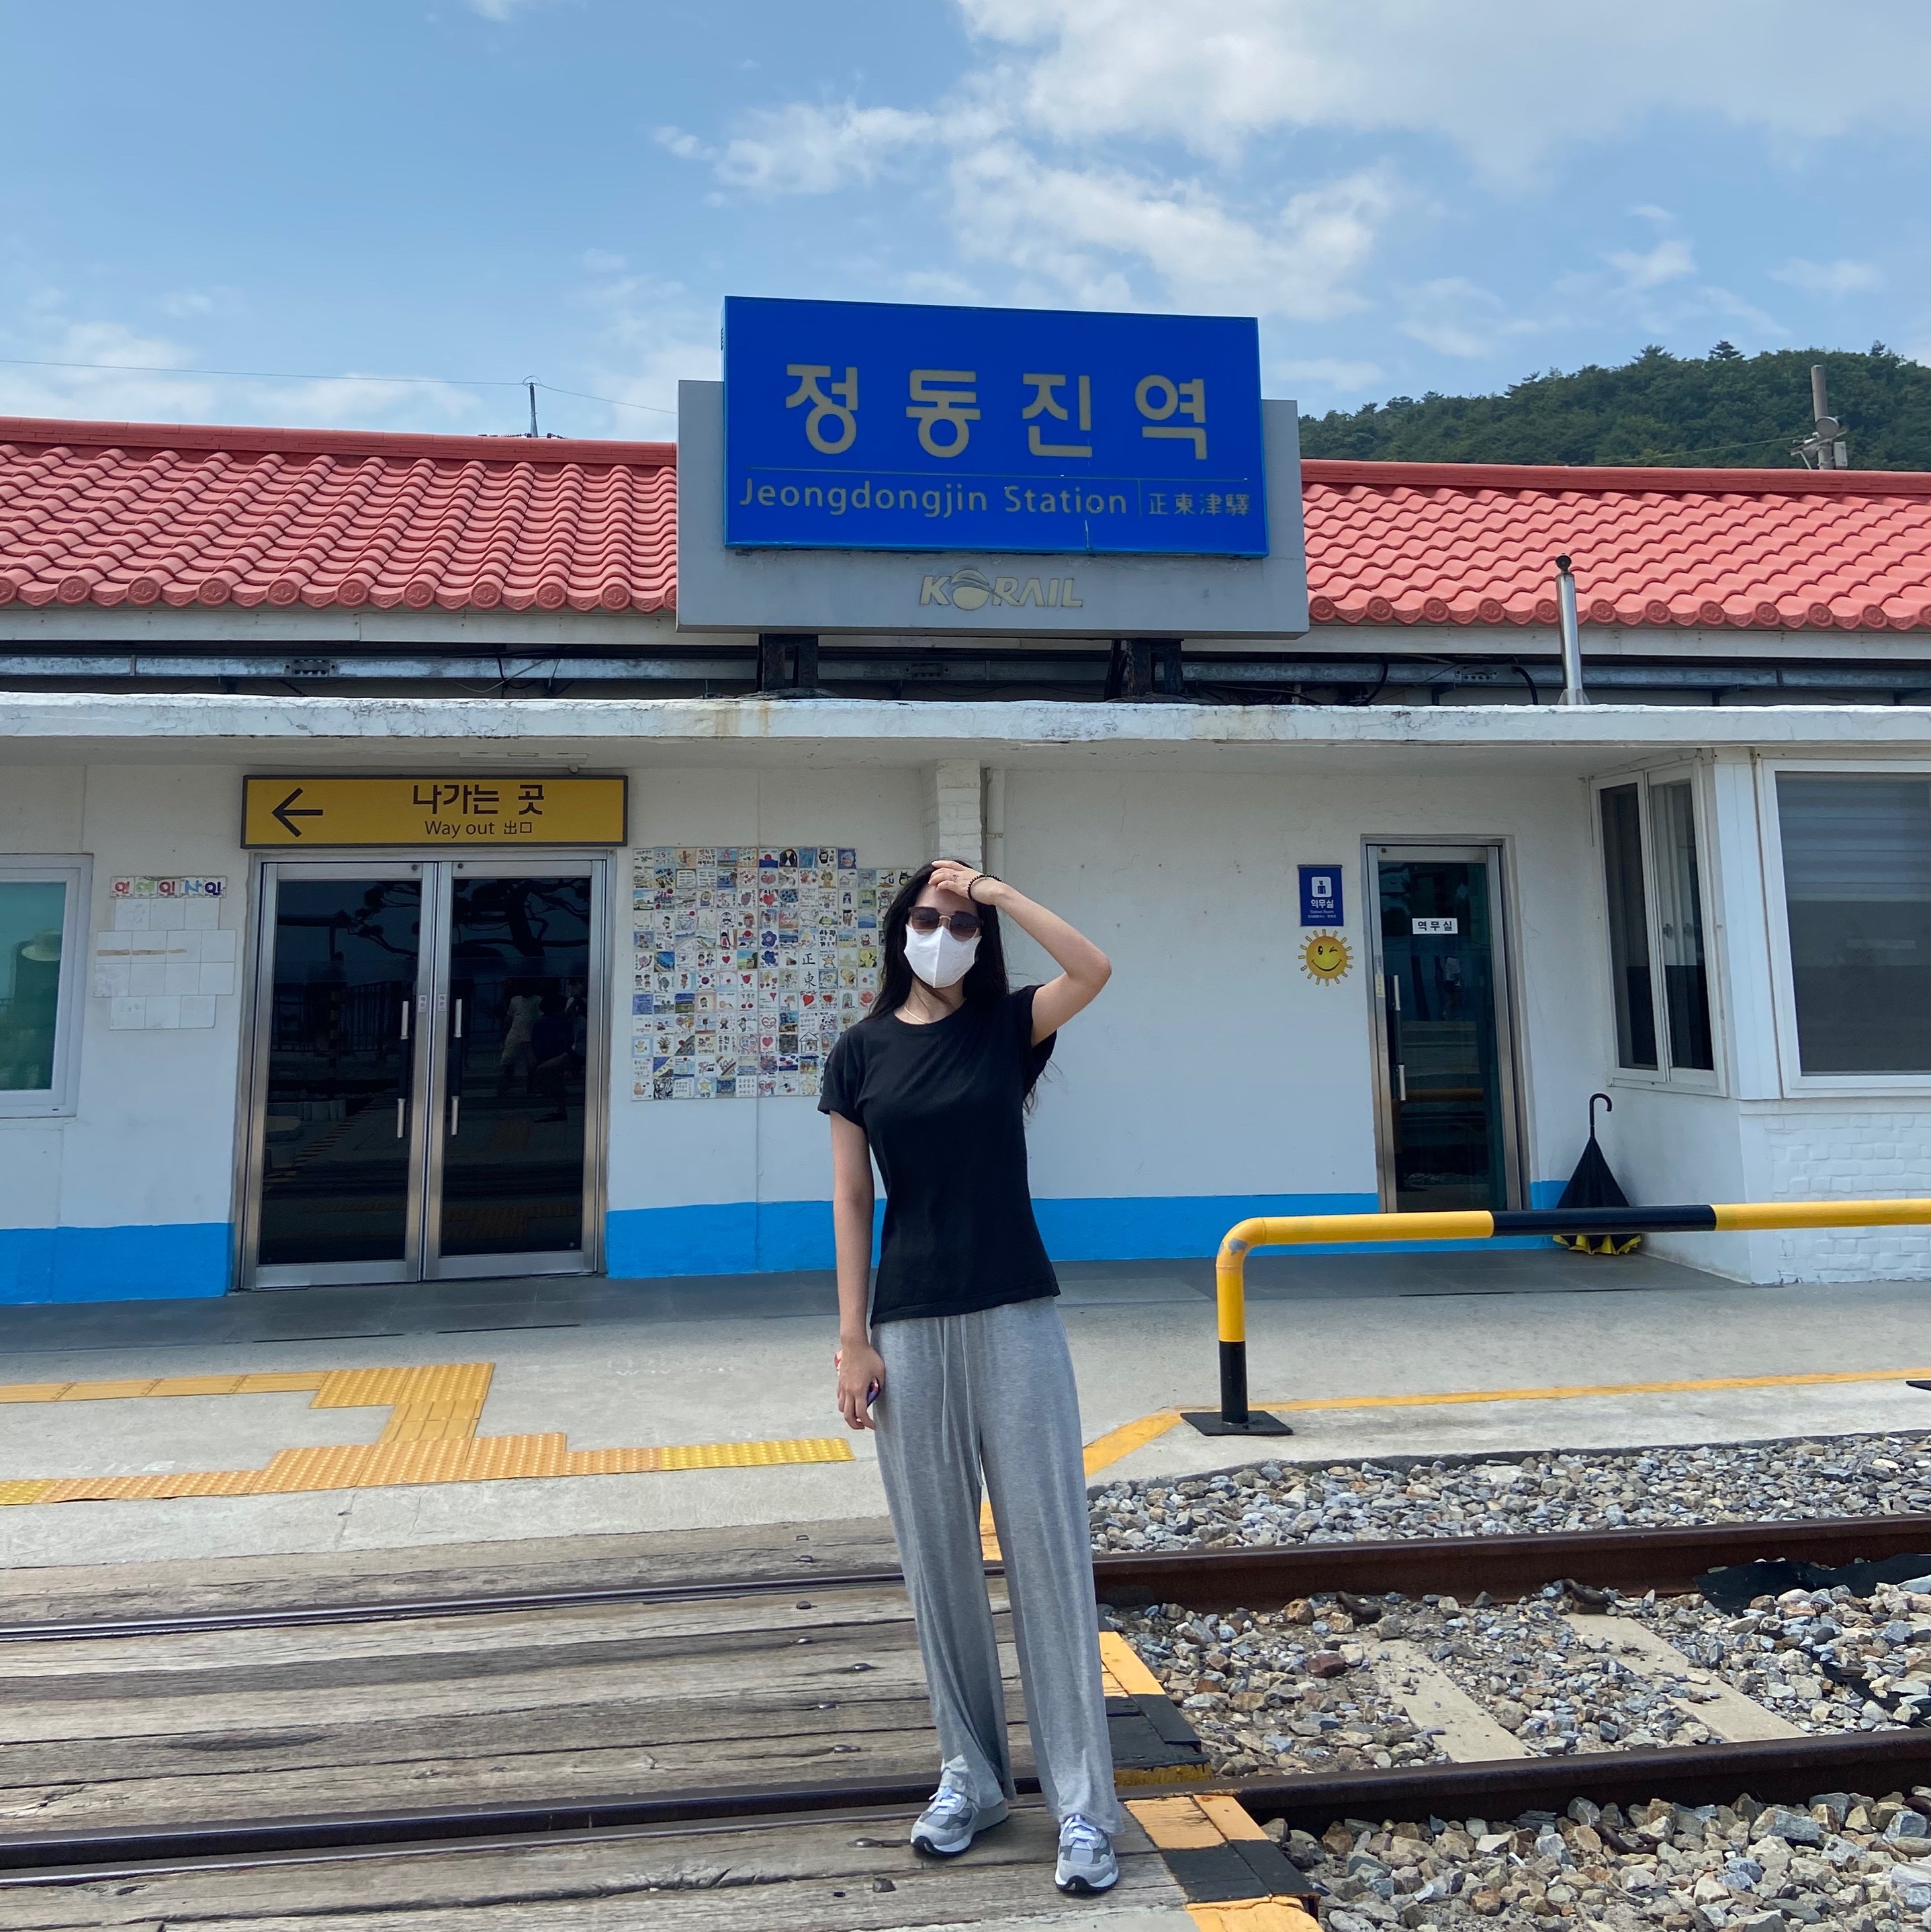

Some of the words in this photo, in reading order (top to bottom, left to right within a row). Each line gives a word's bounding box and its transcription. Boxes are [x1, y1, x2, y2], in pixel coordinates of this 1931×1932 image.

[785, 363, 1208, 460] 정동진역
[739, 478, 987, 518] Jeongdongjin
[1005, 486, 1127, 515] Station
[919, 569, 1083, 611] KORAIL
[412, 784, 500, 815] 나가는
[518, 784, 545, 816] 곳
[424, 820, 461, 839] Way
[465, 822, 495, 835] out
[504, 820, 533, 835] 出口
[1310, 899, 1335, 909] 역무실
[1418, 920, 1453, 932] 역무실
